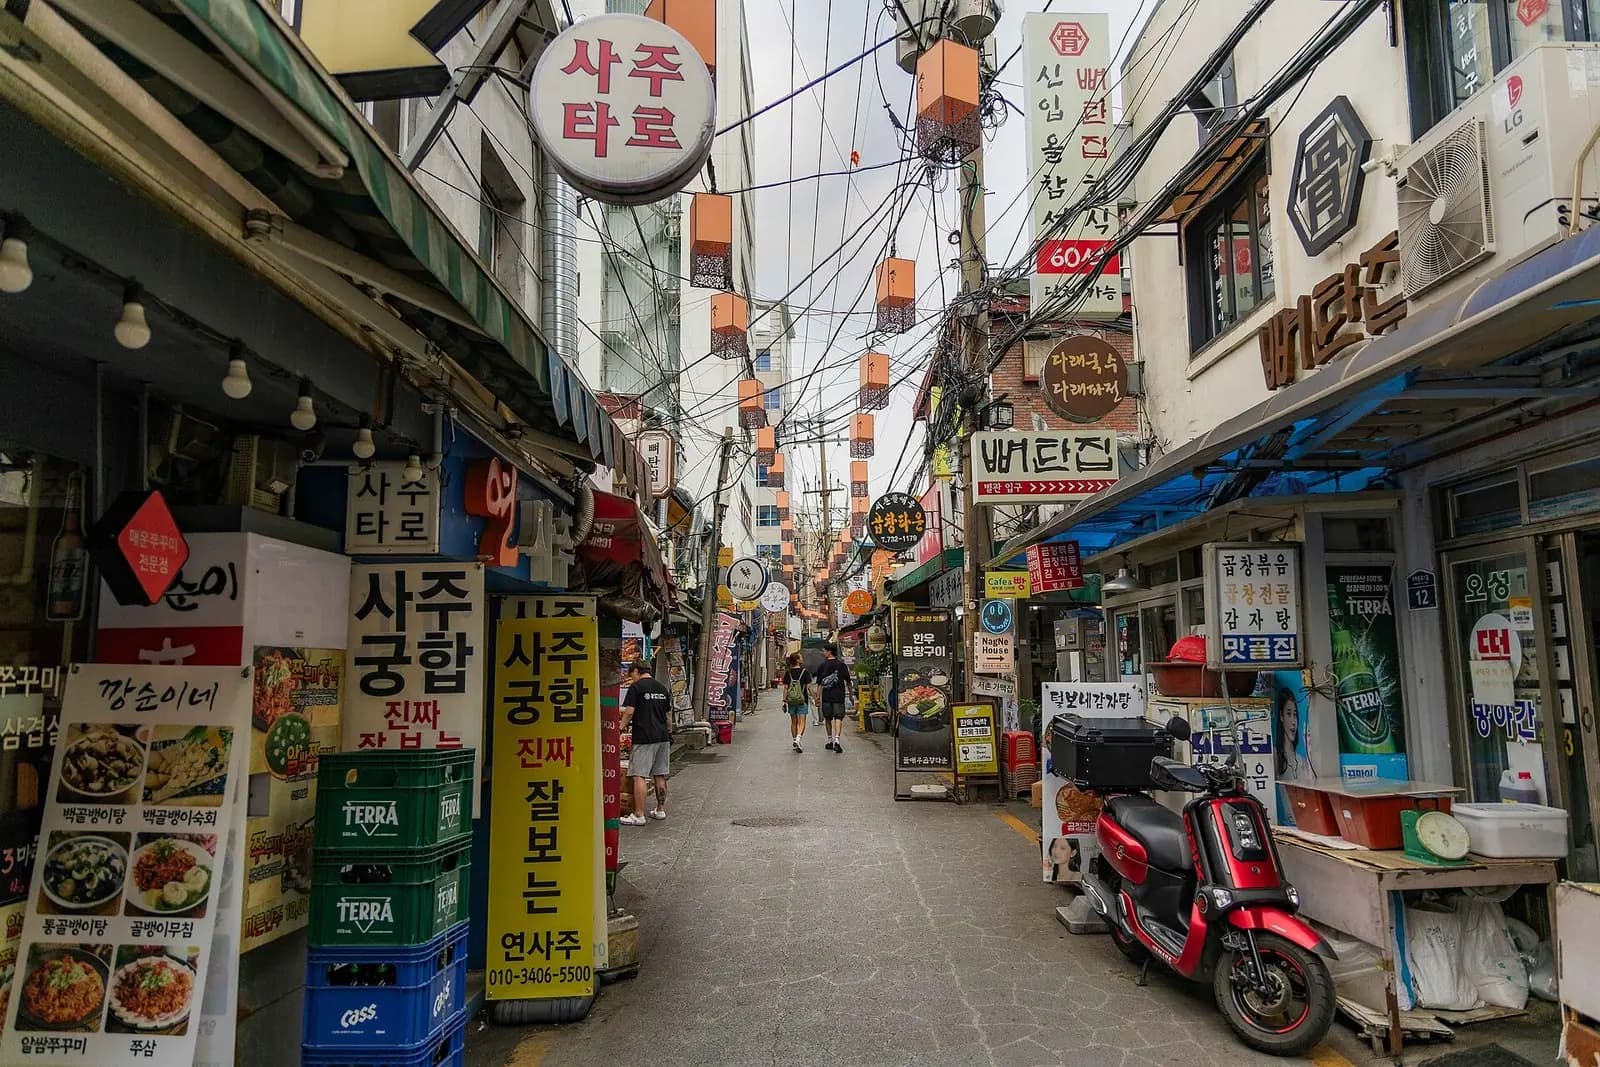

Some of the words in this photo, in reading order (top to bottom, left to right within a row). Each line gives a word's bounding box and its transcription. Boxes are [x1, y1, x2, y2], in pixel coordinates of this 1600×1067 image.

[560, 39, 685, 98] 사주
[562, 102, 683, 158] 타로
[1504, 109, 1523, 134] LG
[1005, 482, 1022, 492] 입구
[356, 510, 428, 543] 타로
[871, 511, 925, 535] 곱창타운
[137, 554, 169, 575] 전문점
[1222, 554, 1289, 577] 곱창볶음
[165, 562, 238, 611] 순이
[1013, 576, 1026, 591] 빵
[355, 571, 473, 632] 사주
[1346, 599, 1392, 616] TERRA
[1416, 589, 1428, 606] 12
[1224, 608, 1291, 631] 감자탕
[913, 633, 935, 645] 한우
[982, 637, 1009, 647] NagNe
[504, 631, 588, 675] 사주
[902, 646, 946, 657] 곱창구이
[982, 647, 1009, 655] House
[354, 632, 473, 697] 궁합
[99, 677, 219, 712] 깡순이네
[503, 678, 589, 725] 궁합
[1050, 691, 1131, 710] 털보네감자탕
[1343, 692, 1382, 713] TERRA
[384, 700, 440, 730] 진짜
[516, 736, 574, 768] 진짜
[63, 807, 127, 825] 백골뱅이탕
[143, 808, 217, 826] 백골뱅이숙회
[342, 805, 399, 826] TERRA
[441, 797, 460, 820] TERRA
[438, 886, 457, 913] TERRA
[337, 902, 394, 923] TERRA
[42, 919, 108, 937] 통골뱅이탕
[130, 920, 194, 938] 골뱅이무침
[501, 930, 581, 962] 연사주
[489, 965, 591, 986] 010-3406-5500
[341, 1004, 376, 1028] Cass
[21, 1037, 87, 1055] 알쌈쭈꾸미
[130, 1039, 157, 1057] 쭈삼
